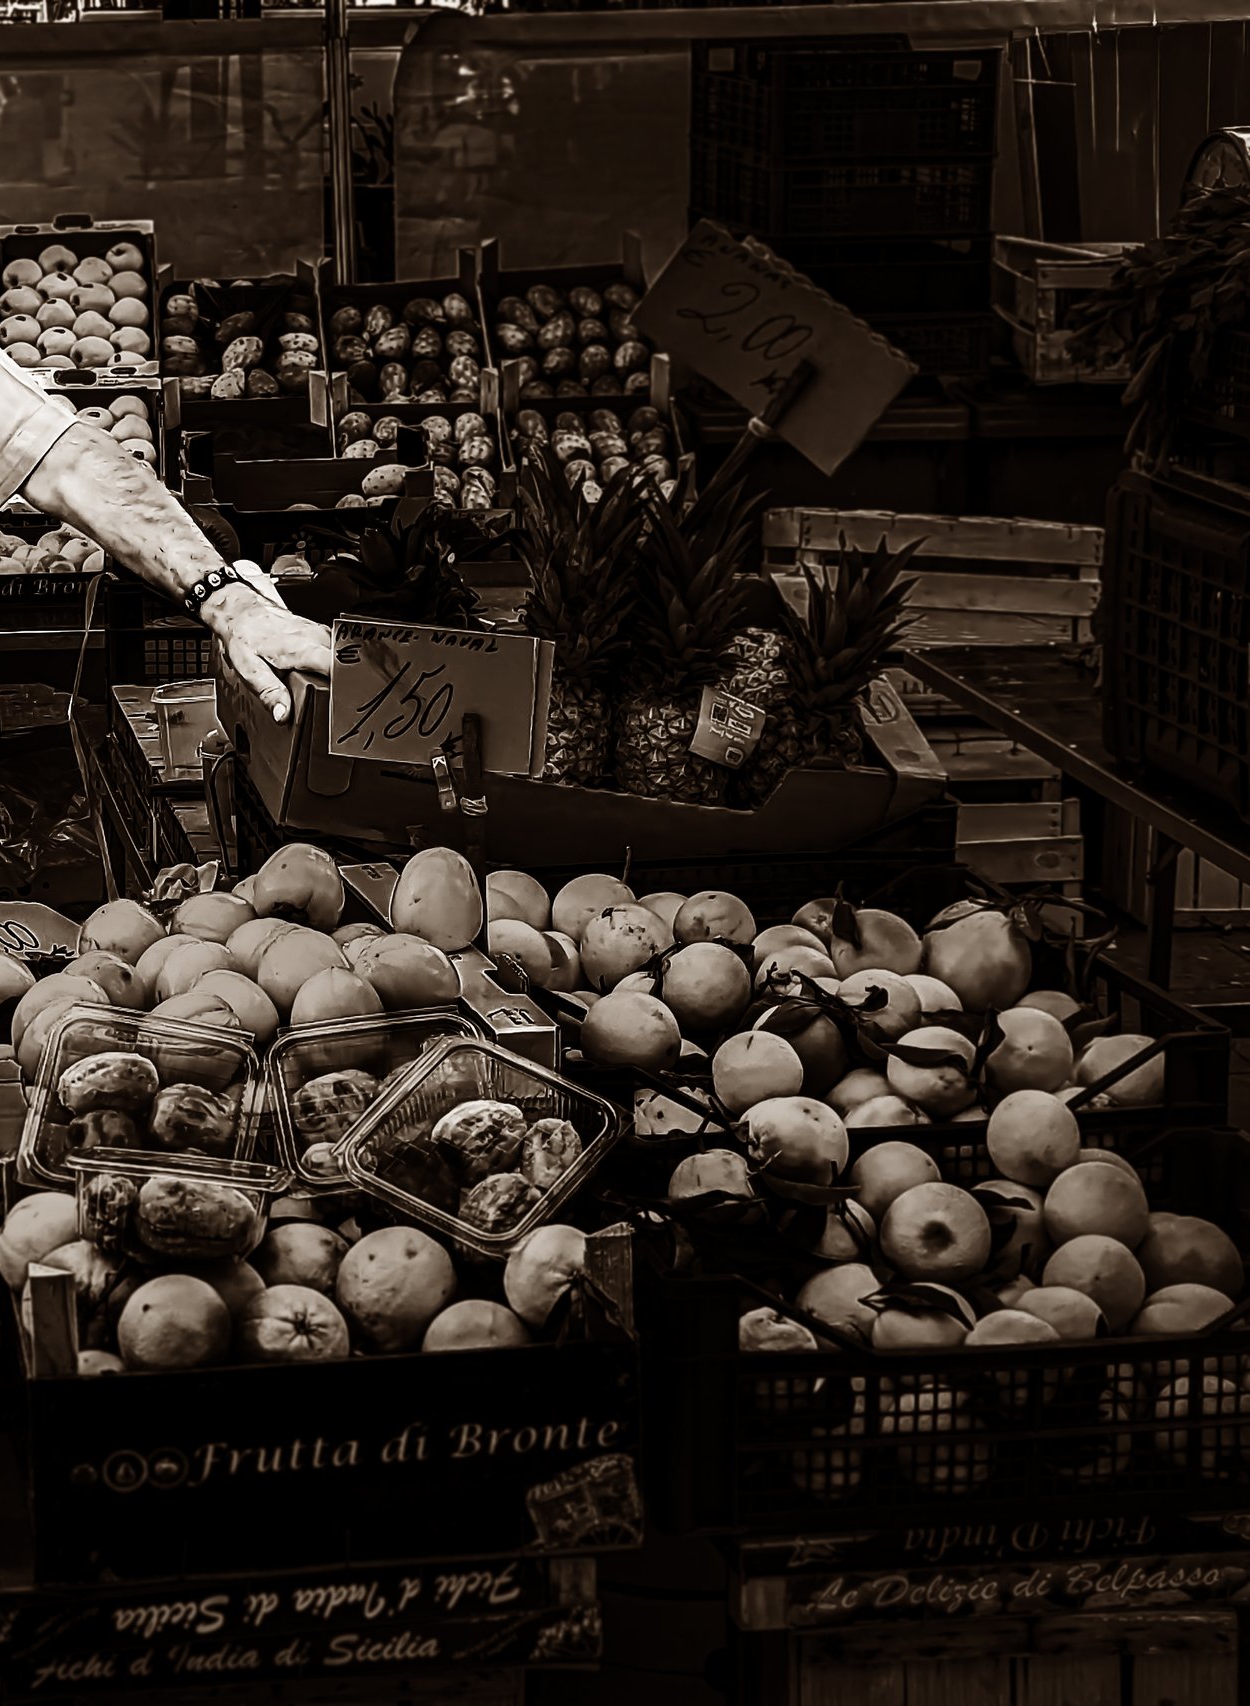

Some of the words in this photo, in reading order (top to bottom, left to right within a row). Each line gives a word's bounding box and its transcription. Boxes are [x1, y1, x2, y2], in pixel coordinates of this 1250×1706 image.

[676, 282, 813, 360] 2,00
[1, 577, 23, 596] di
[336, 644, 362, 664] €
[431, 632, 498, 653] NAVAL
[337, 661, 454, 751] 1,50
[185, 1436, 362, 1489] Frutta
[380, 1419, 430, 1464] di
[449, 1415, 621, 1461] Bronte
[1057, 1514, 1157, 1555] Fichi
[434, 1561, 522, 1609] Fichi
[871, 1573, 1000, 1614] Delizie
[1012, 1567, 1054, 1599] di
[1065, 1562, 1222, 1598] Belpasso
[111, 1593, 231, 1639] Sicilia
[242, 1592, 280, 1628] di
[272, 1639, 310, 1669] di
[322, 1630, 442, 1667] Sicilia
